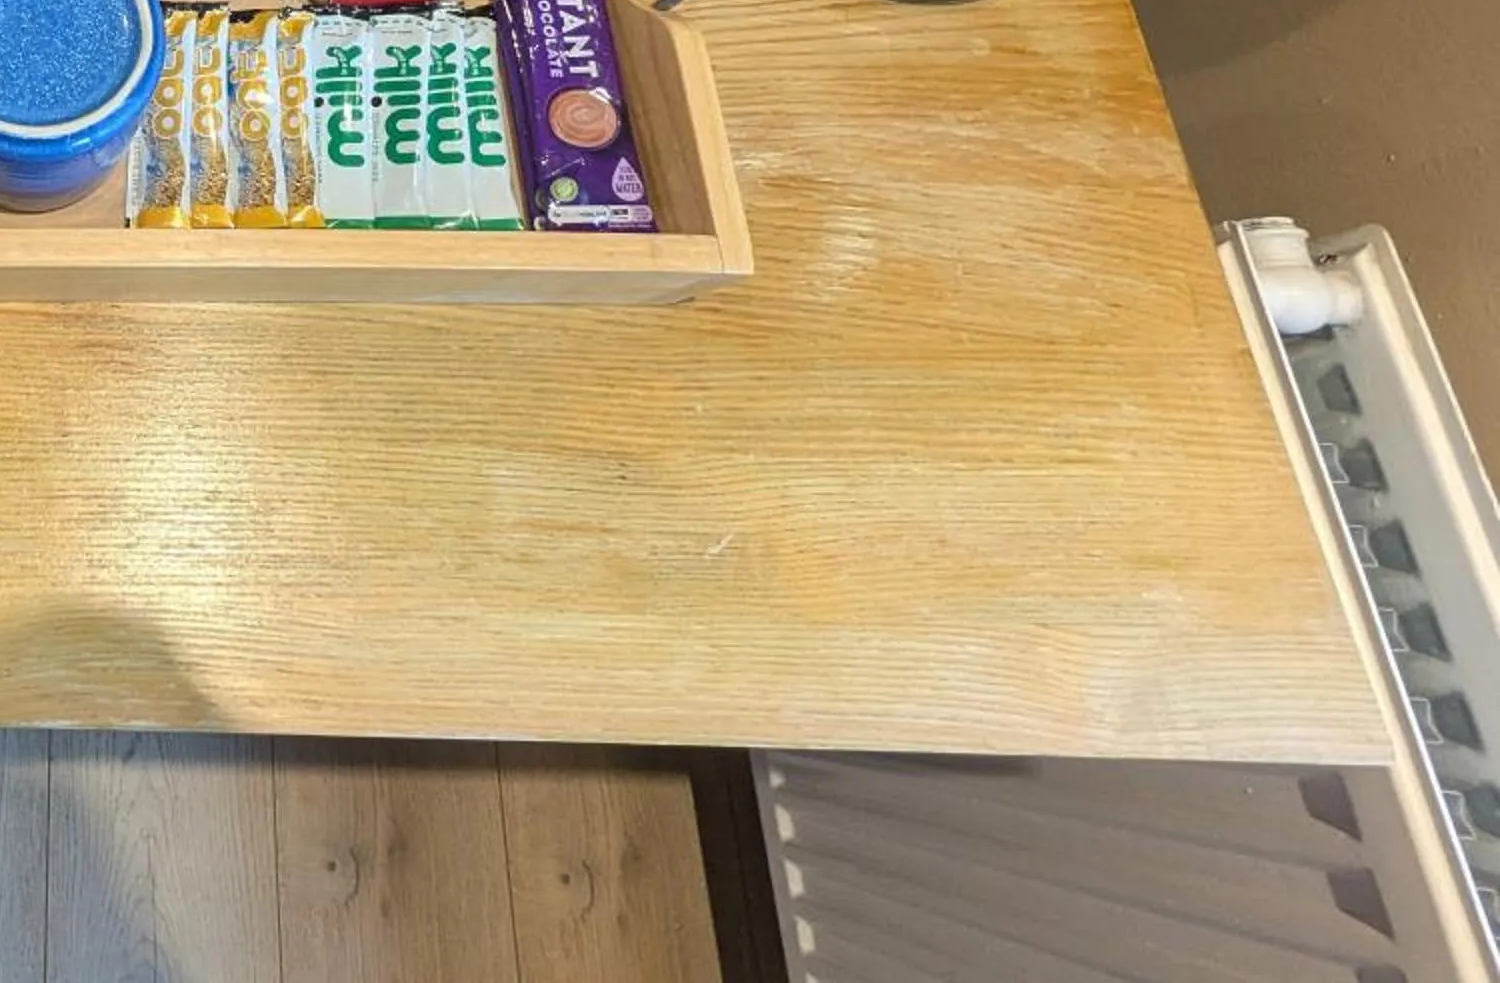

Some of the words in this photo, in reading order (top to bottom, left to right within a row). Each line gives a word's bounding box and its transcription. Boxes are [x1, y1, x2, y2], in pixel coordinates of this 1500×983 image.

[314, 44, 365, 167] milk
[371, 44, 422, 165] milk
[426, 42, 465, 165] milk
[463, 45, 506, 167] milk
